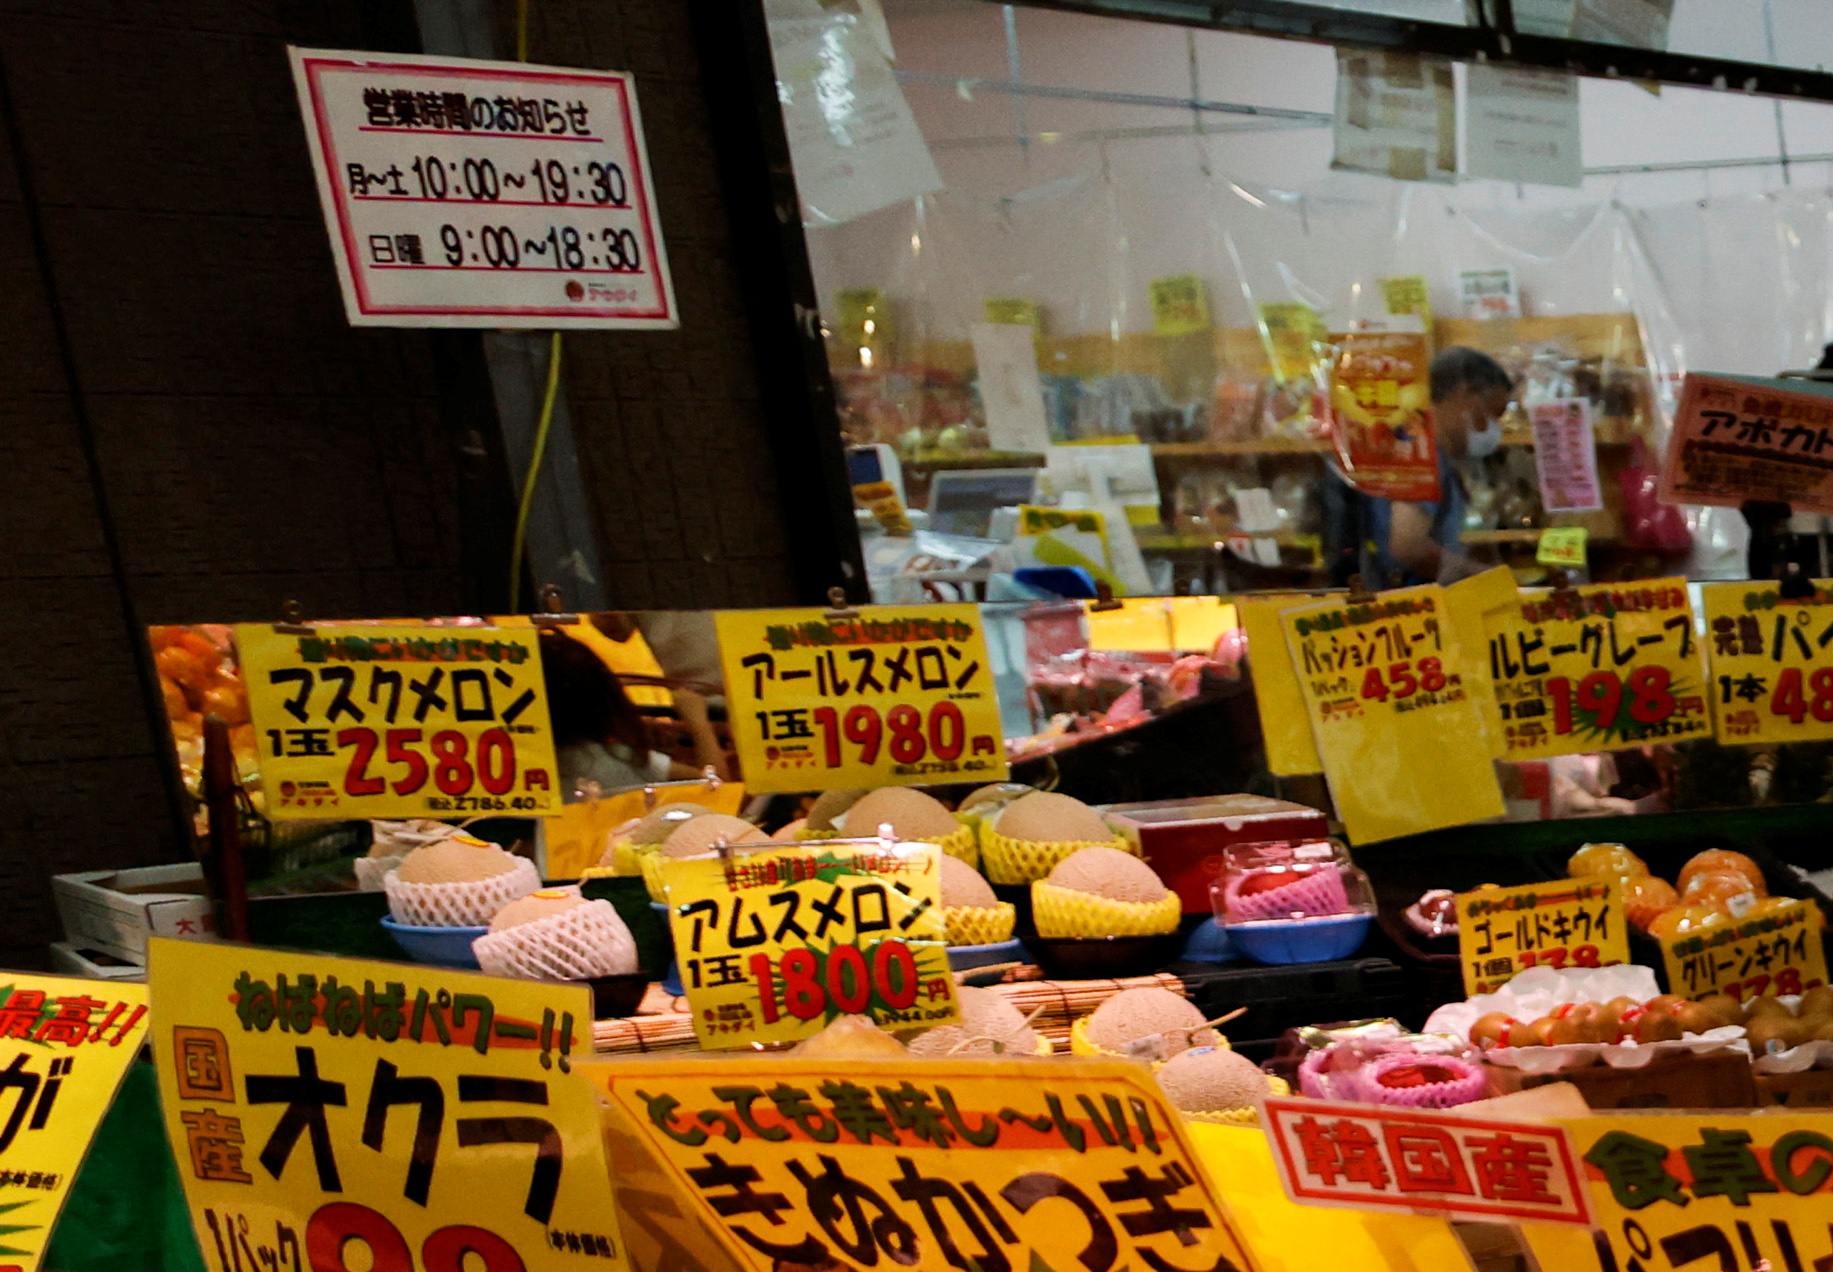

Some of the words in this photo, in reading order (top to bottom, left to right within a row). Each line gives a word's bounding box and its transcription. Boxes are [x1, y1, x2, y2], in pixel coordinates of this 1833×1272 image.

[363, 87, 591, 136] 営業時間のお知らせ
[269, 666, 536, 724] マスクメロン
[741, 646, 979, 700] アールスメロン
[1719, 672, 1768, 703] 1本
[266, 728, 336, 758] 1玉
[755, 708, 815, 740] 1玉
[679, 882, 932, 952] アムスメロン
[1474, 904, 1609, 955] ゴールドキウイ
[688, 954, 748, 988] 1玉
[244, 1046, 564, 1226] オクラ
[1293, 1116, 1564, 1206] 韓国産
